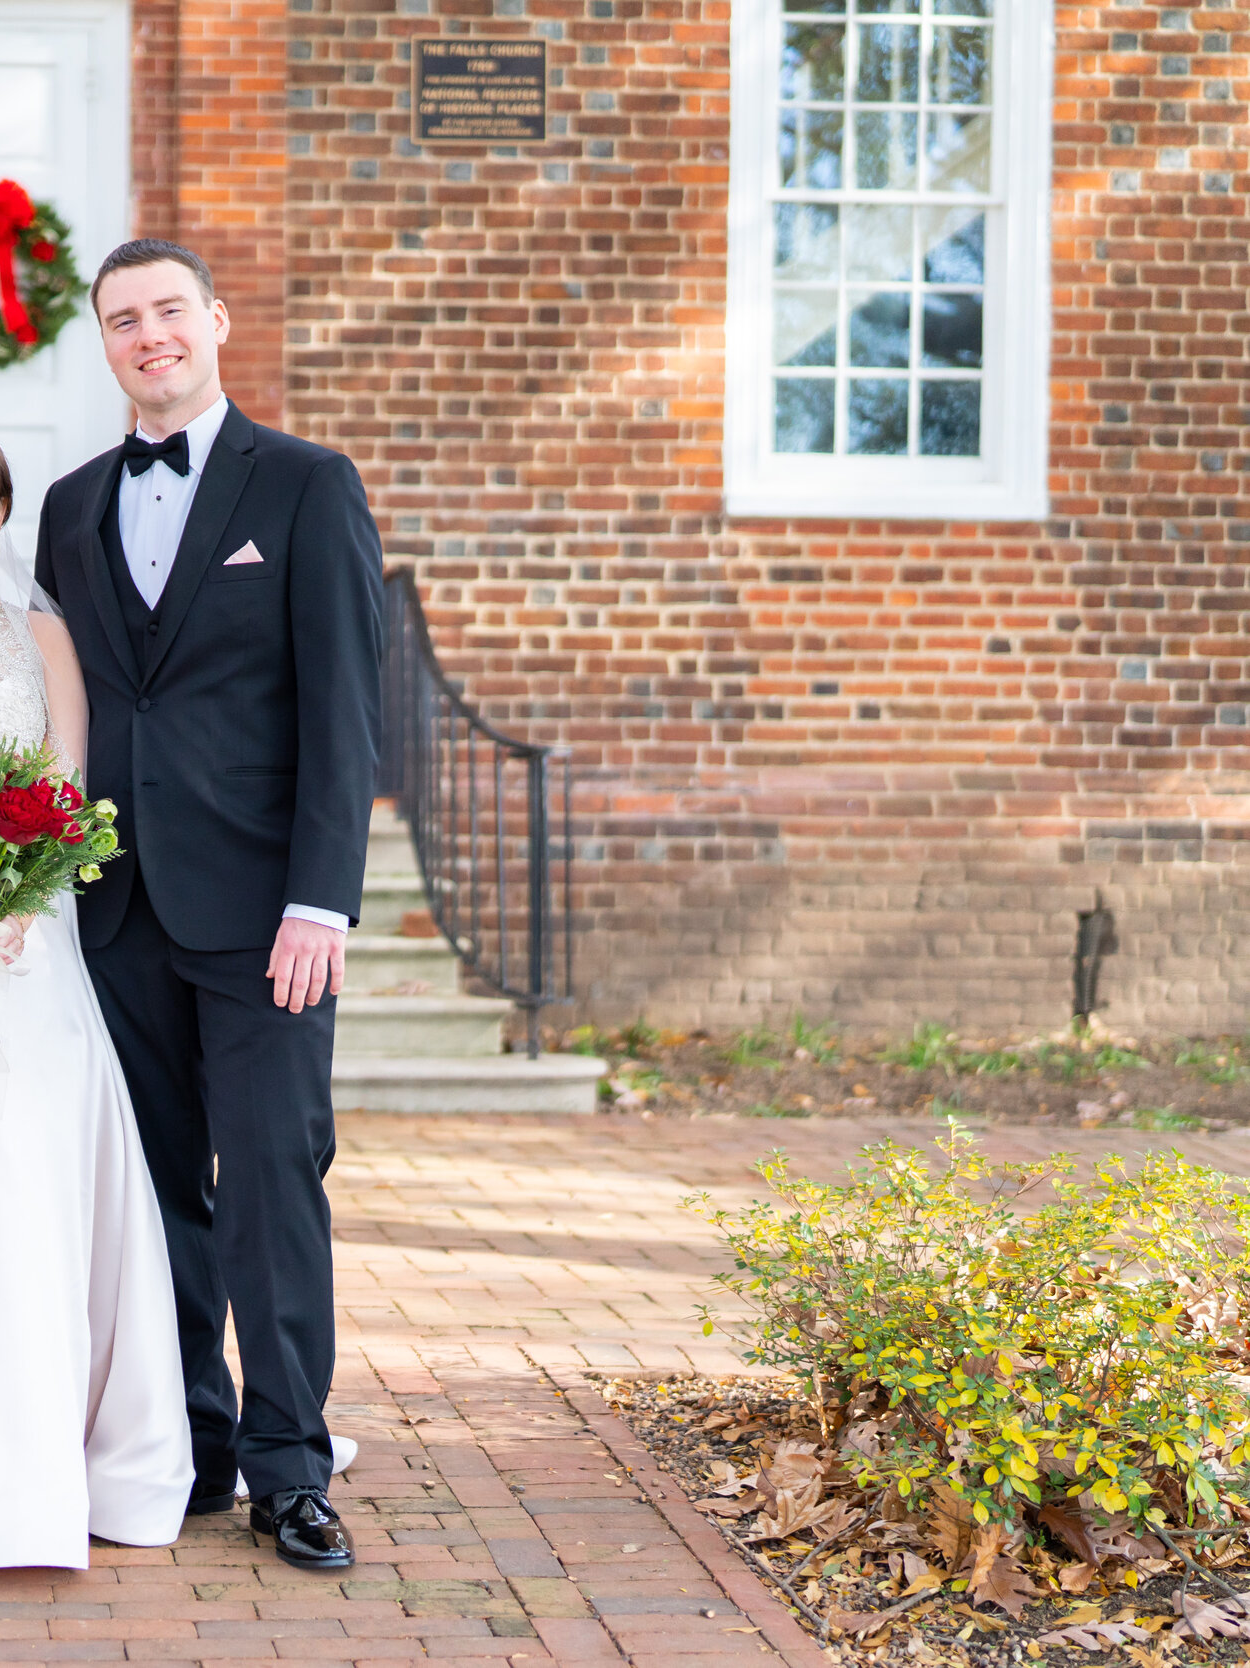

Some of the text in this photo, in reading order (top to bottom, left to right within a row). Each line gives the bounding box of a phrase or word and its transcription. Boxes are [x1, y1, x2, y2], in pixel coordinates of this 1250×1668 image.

[423, 42, 541, 57] THE FALLS CHURCH
[421, 88, 540, 101] NATIONAL REGISTER
[419, 102, 541, 115] OF HISTORIC PLACES
